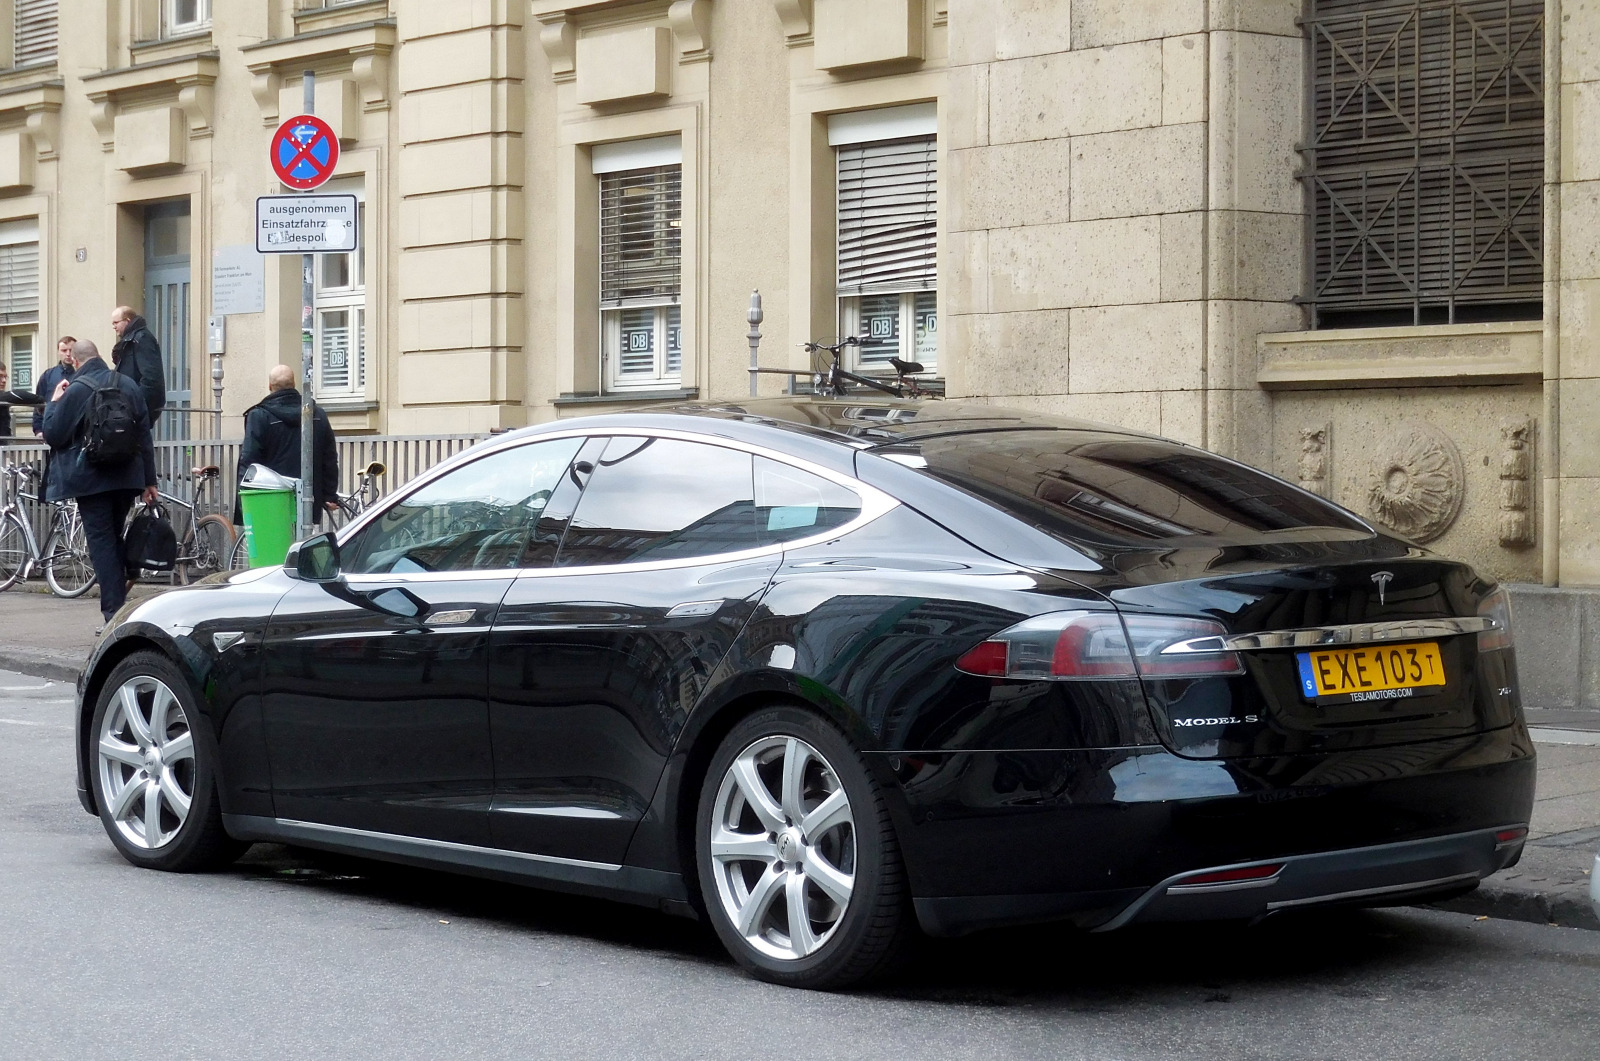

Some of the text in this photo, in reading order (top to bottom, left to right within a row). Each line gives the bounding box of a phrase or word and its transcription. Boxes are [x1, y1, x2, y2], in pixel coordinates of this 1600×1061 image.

[269, 205, 347, 215] ausgenommen
[262, 218, 352, 229] Einsatzfahrze
[873, 319, 890, 335] DB
[632, 334, 646, 348] DB
[331, 352, 343, 364] DB
[1306, 680, 1313, 690] S
[1350, 688, 1413, 702] TESLAMOTORS.COM
[1173, 714, 1258, 727] MODEL S
